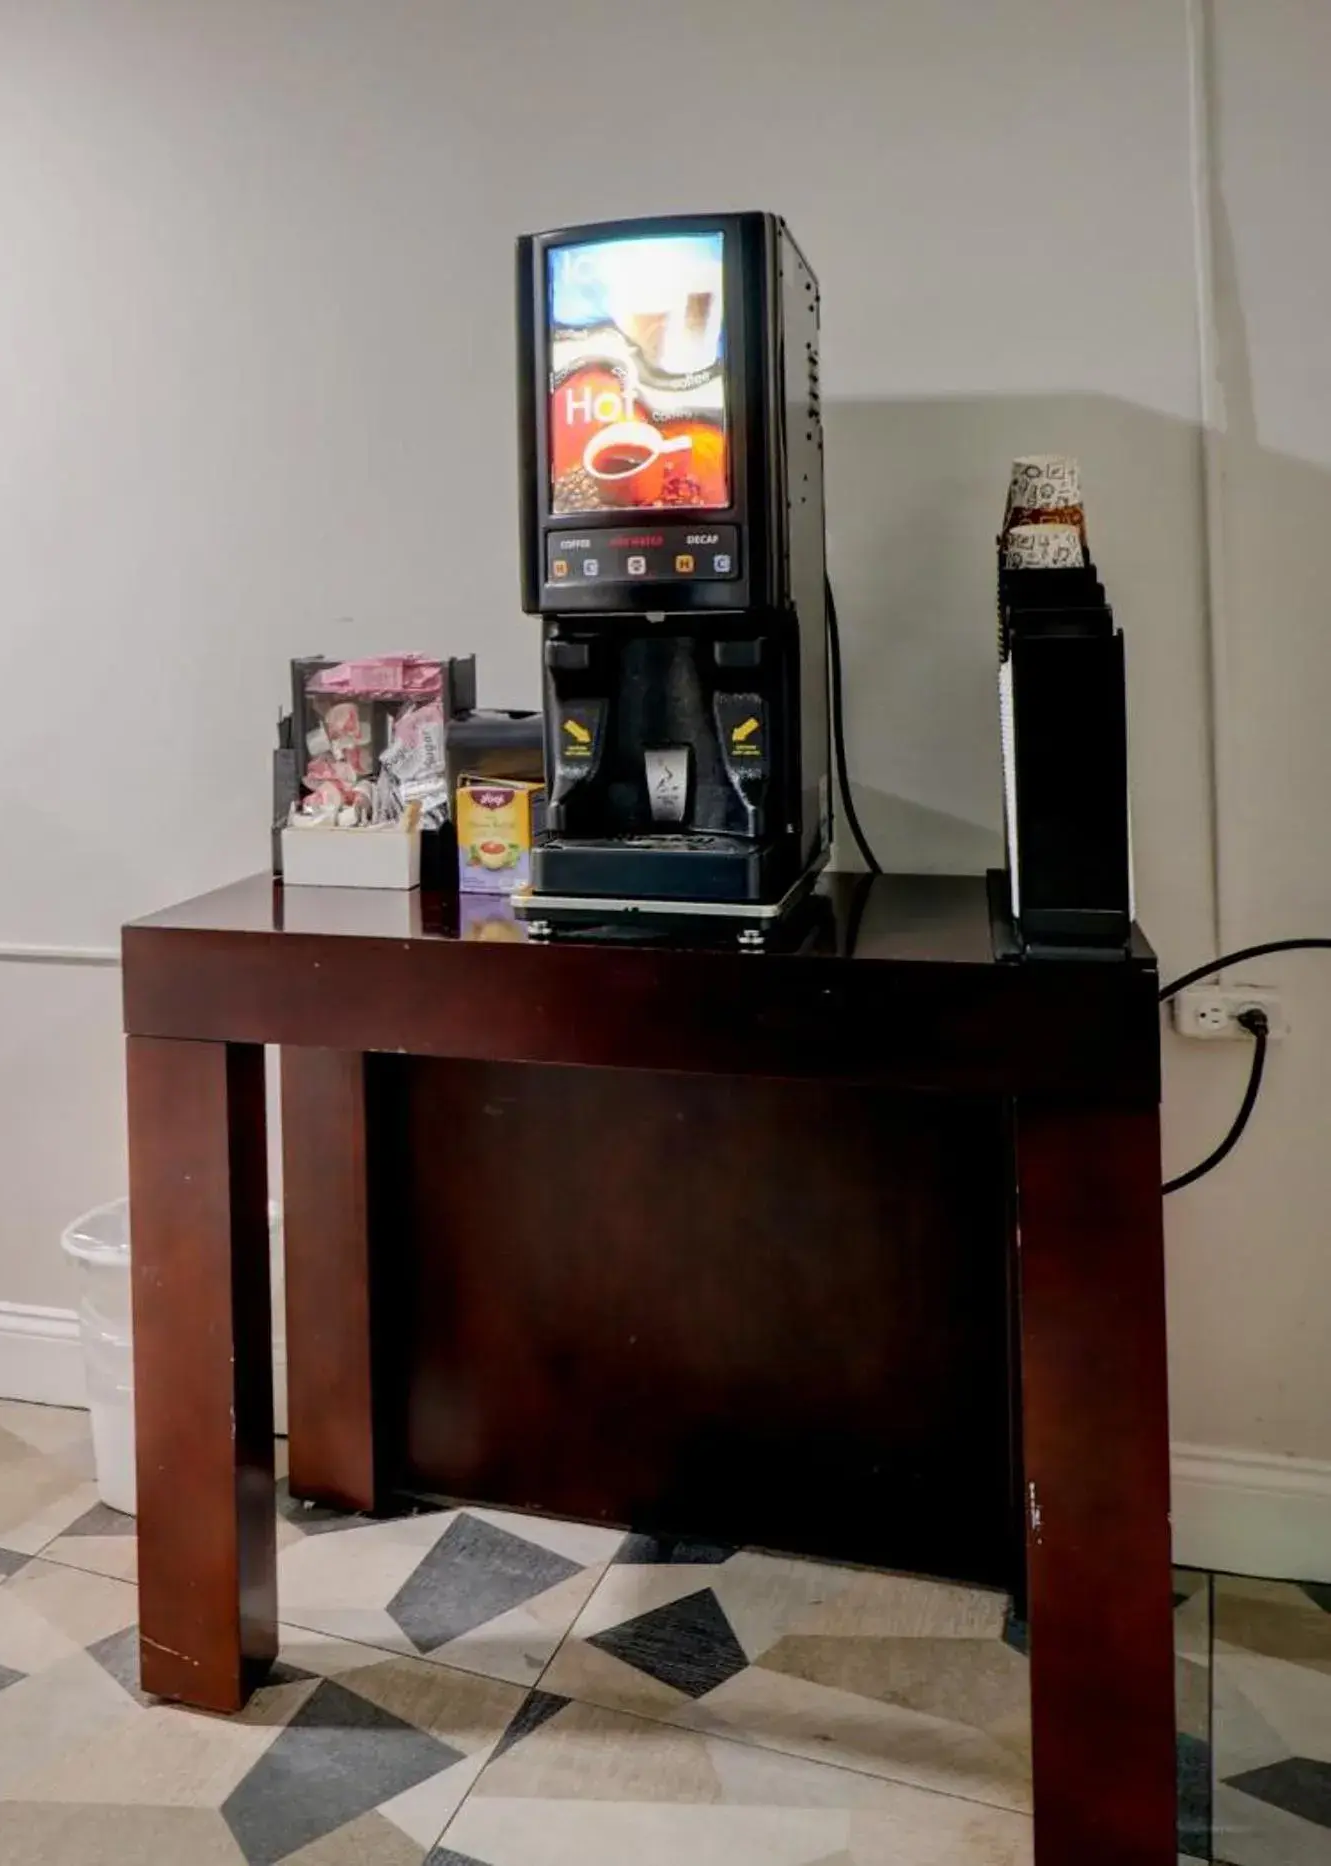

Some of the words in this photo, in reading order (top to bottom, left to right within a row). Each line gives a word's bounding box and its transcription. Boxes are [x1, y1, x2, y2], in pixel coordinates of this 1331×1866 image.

[565, 385, 638, 424] Hot
[560, 539, 591, 550] COFFEE
[686, 533, 720, 545] DECAF
